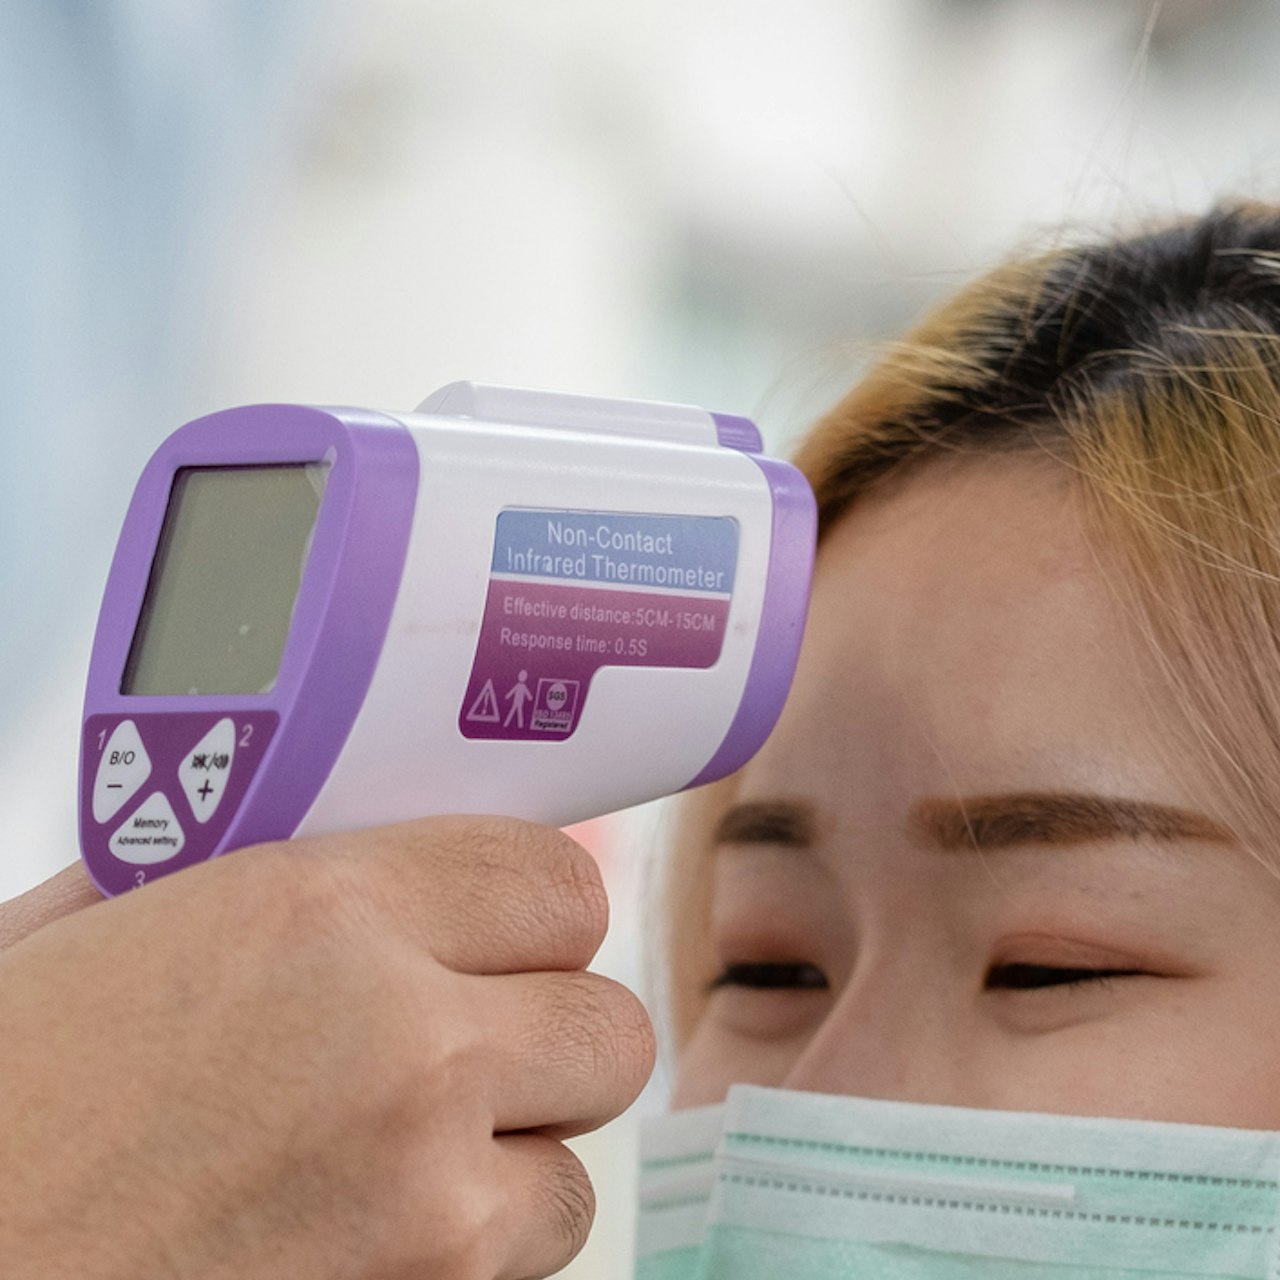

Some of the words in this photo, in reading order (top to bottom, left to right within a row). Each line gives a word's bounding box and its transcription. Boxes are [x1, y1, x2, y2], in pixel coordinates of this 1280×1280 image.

[547, 520, 673, 555] Non-Contact
[507, 546, 586, 577] Infrared
[591, 554, 725, 588] Thermometer
[503, 596, 567, 619] Effective
[500, 627, 573, 652] Response
[576, 635, 612, 653] time:
[614, 637, 648, 657] 0.5S
[97, 729, 107, 750] 1
[238, 724, 254, 747] 2
[109, 751, 136, 765] B/O
[133, 817, 169, 831] Memory
[117, 836, 152, 846] Advanced
[153, 836, 178, 847] setting
[132, 870, 146, 888] 3
